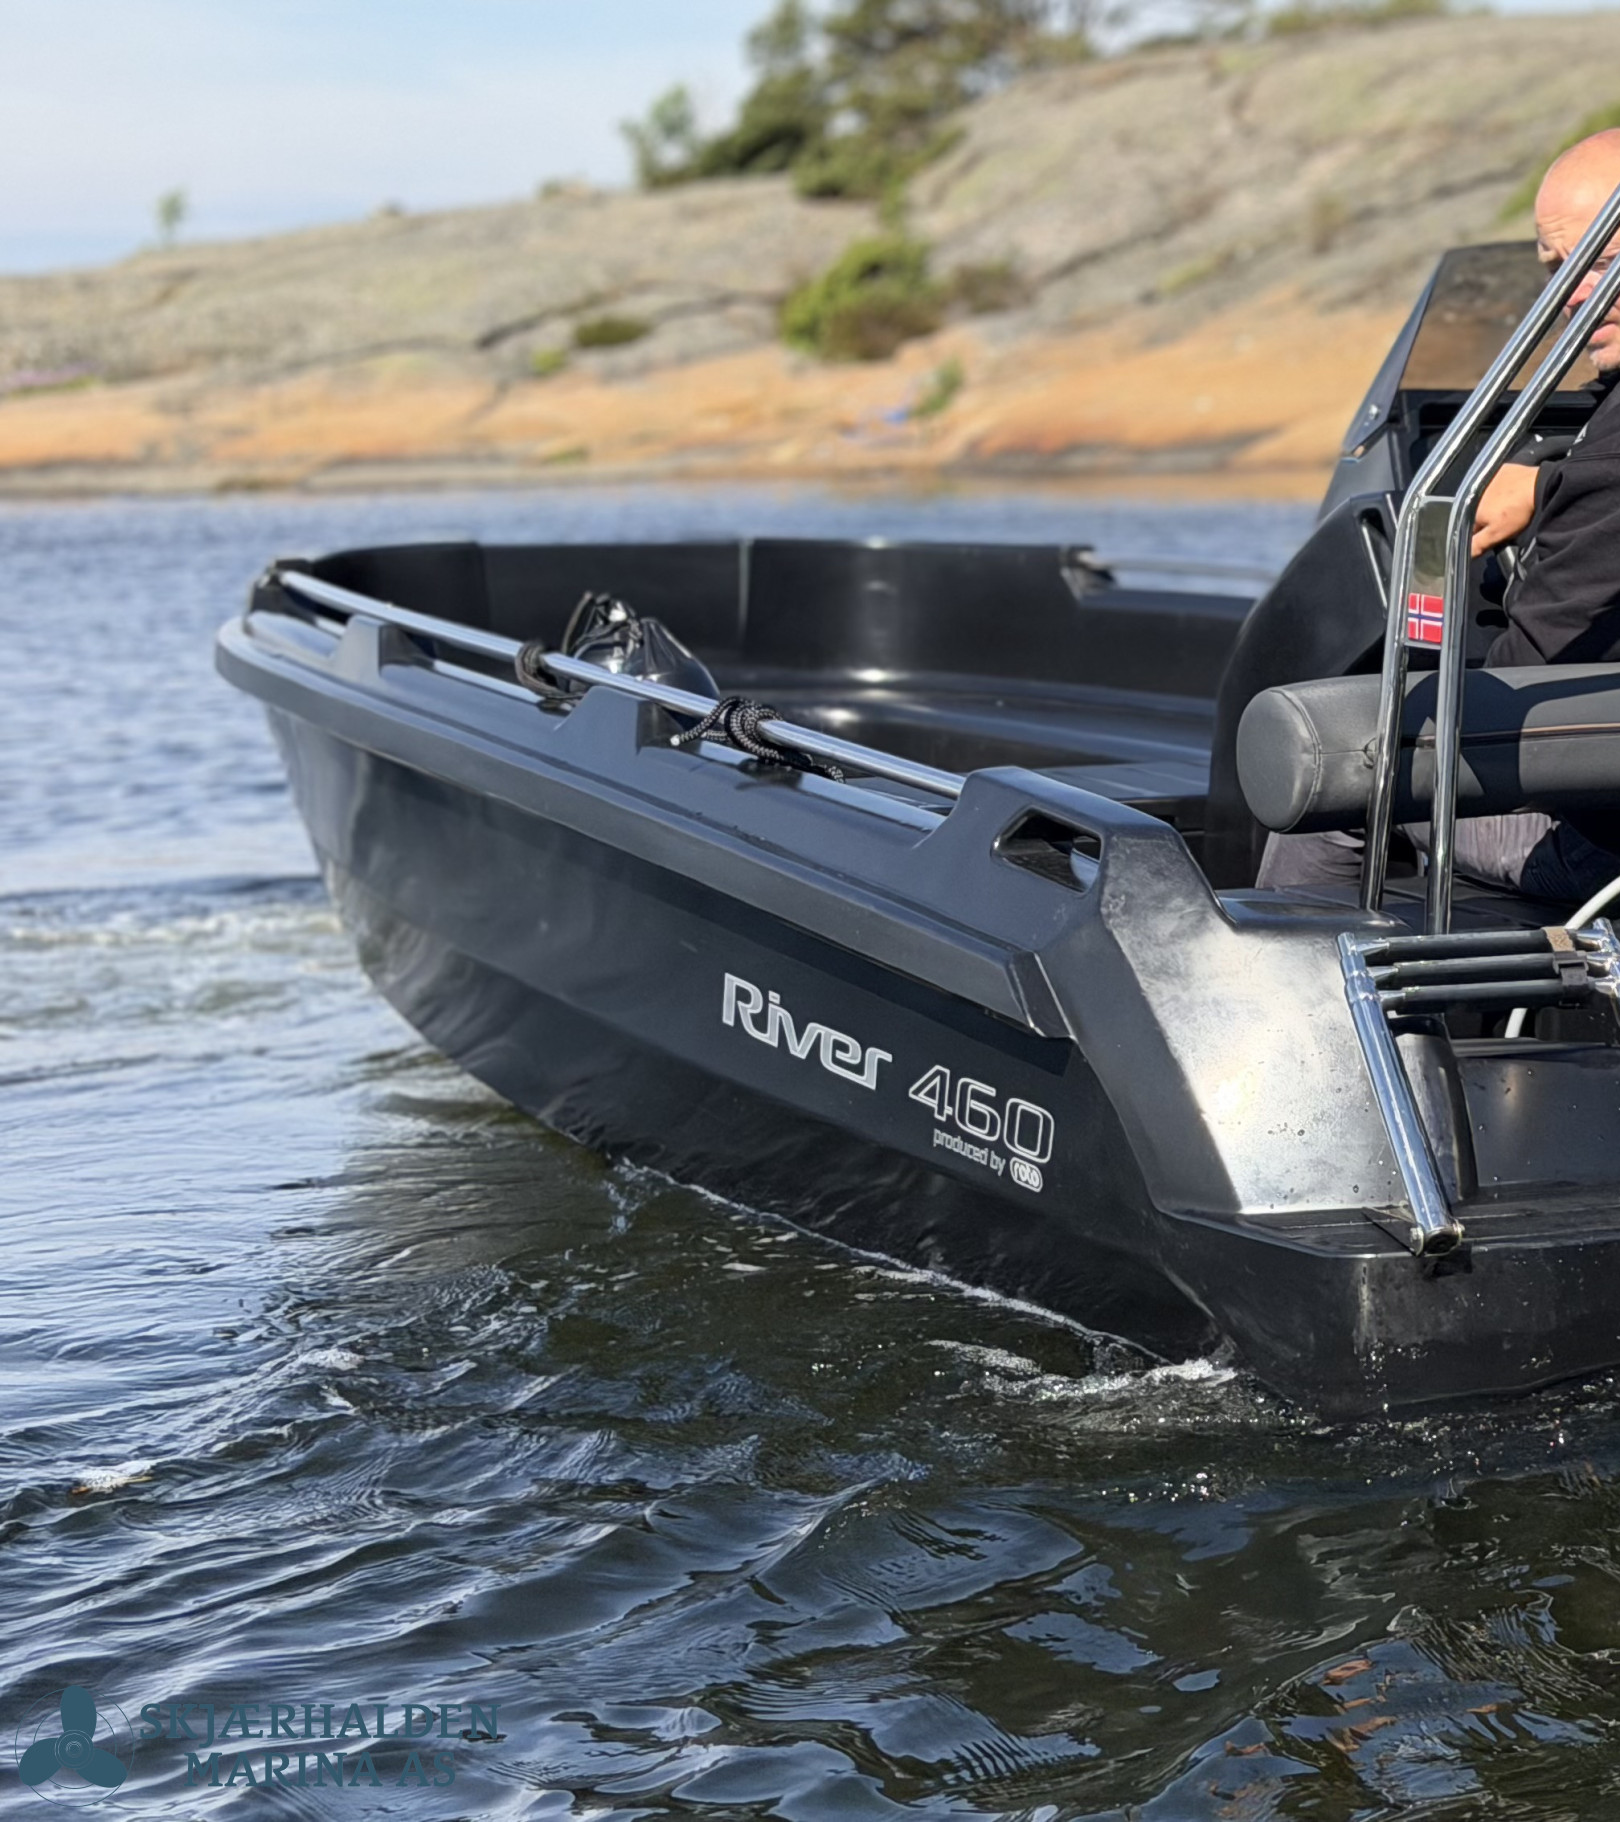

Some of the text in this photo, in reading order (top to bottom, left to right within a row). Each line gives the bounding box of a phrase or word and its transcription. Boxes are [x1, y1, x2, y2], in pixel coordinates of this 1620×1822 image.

[722, 972, 1055, 1163] River 460
[933, 1128, 988, 1166] produced
[989, 1150, 1006, 1177] by
